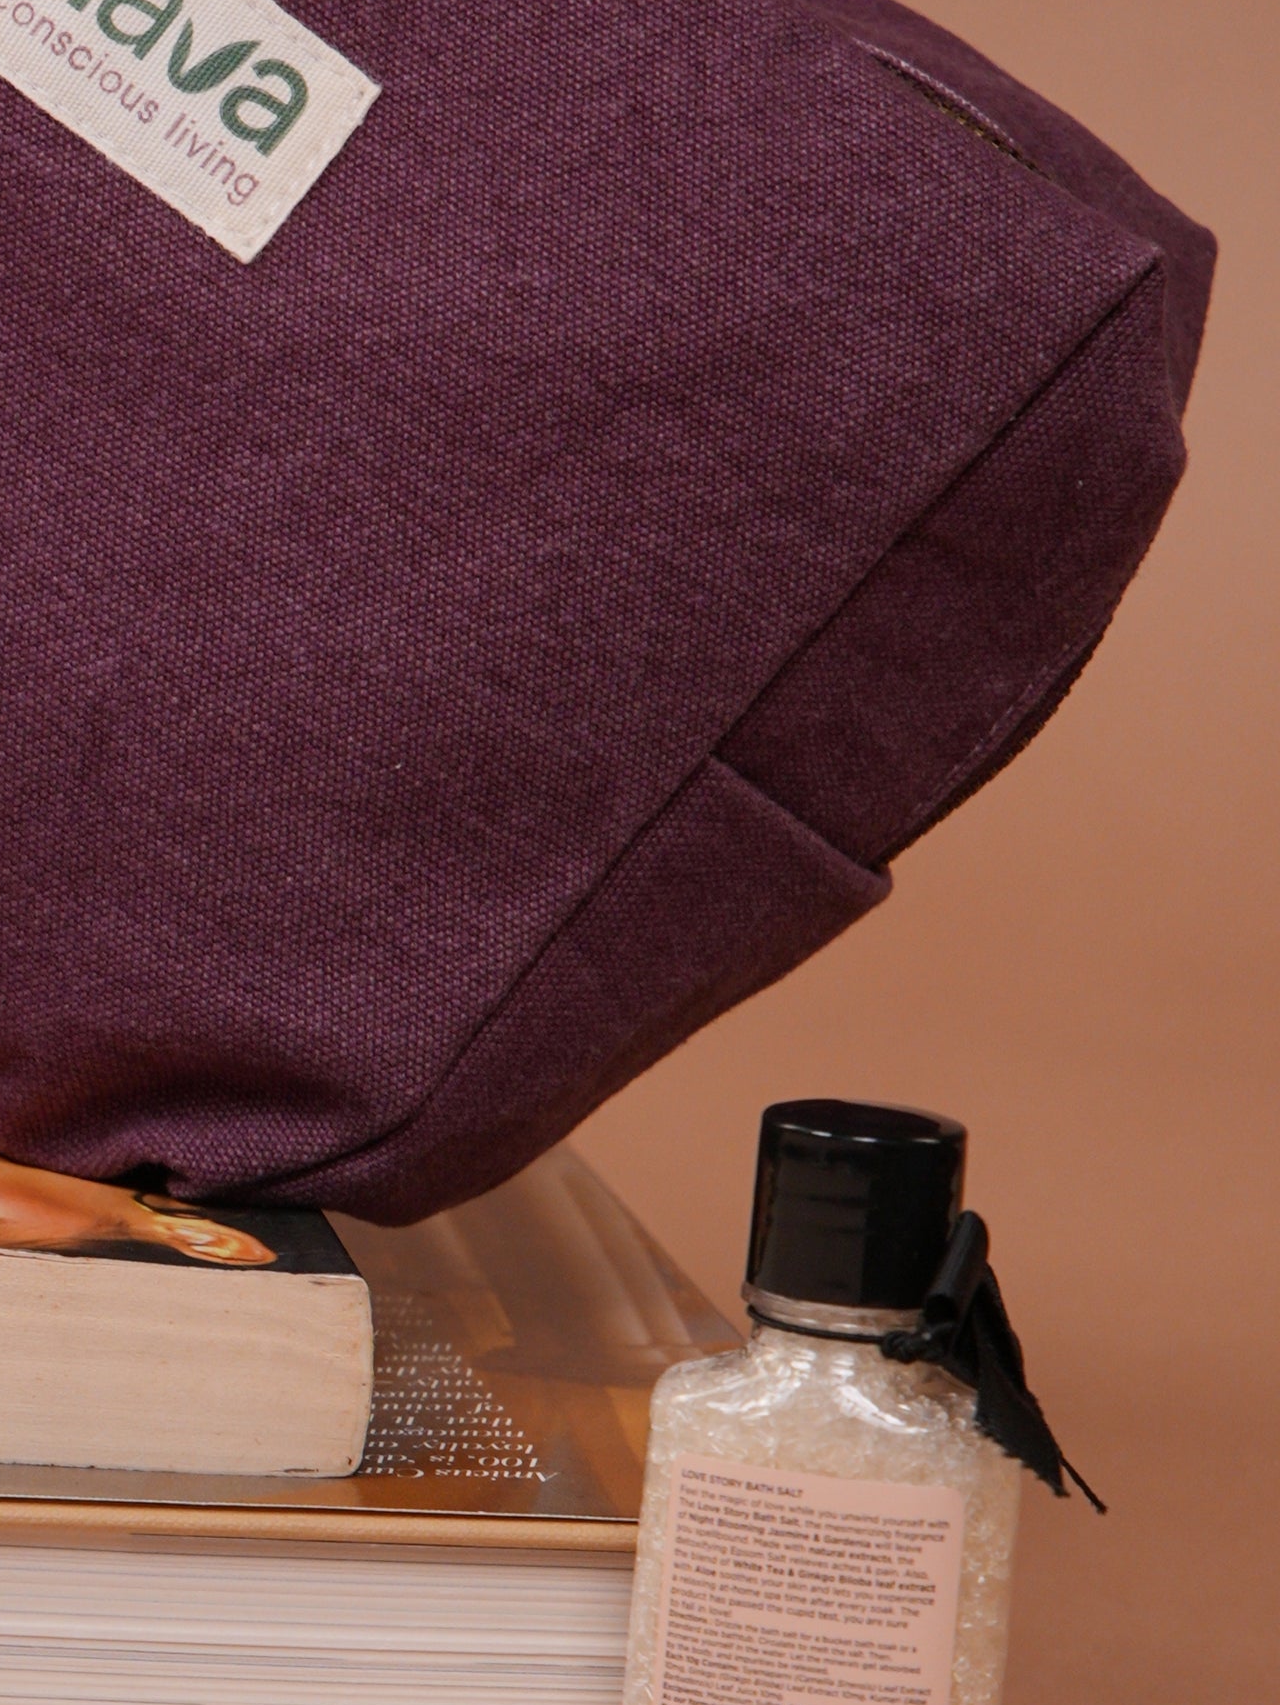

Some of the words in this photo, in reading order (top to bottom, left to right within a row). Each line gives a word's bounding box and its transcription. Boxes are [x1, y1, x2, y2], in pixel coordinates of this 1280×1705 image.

[165, 112, 260, 205] living
[466, 1402, 504, 1414] of
[436, 1416, 513, 1427] that.
[412, 1439, 533, 1454] loyally
[429, 1455, 455, 1466] is
[435, 1468, 559, 1482] Amicus
